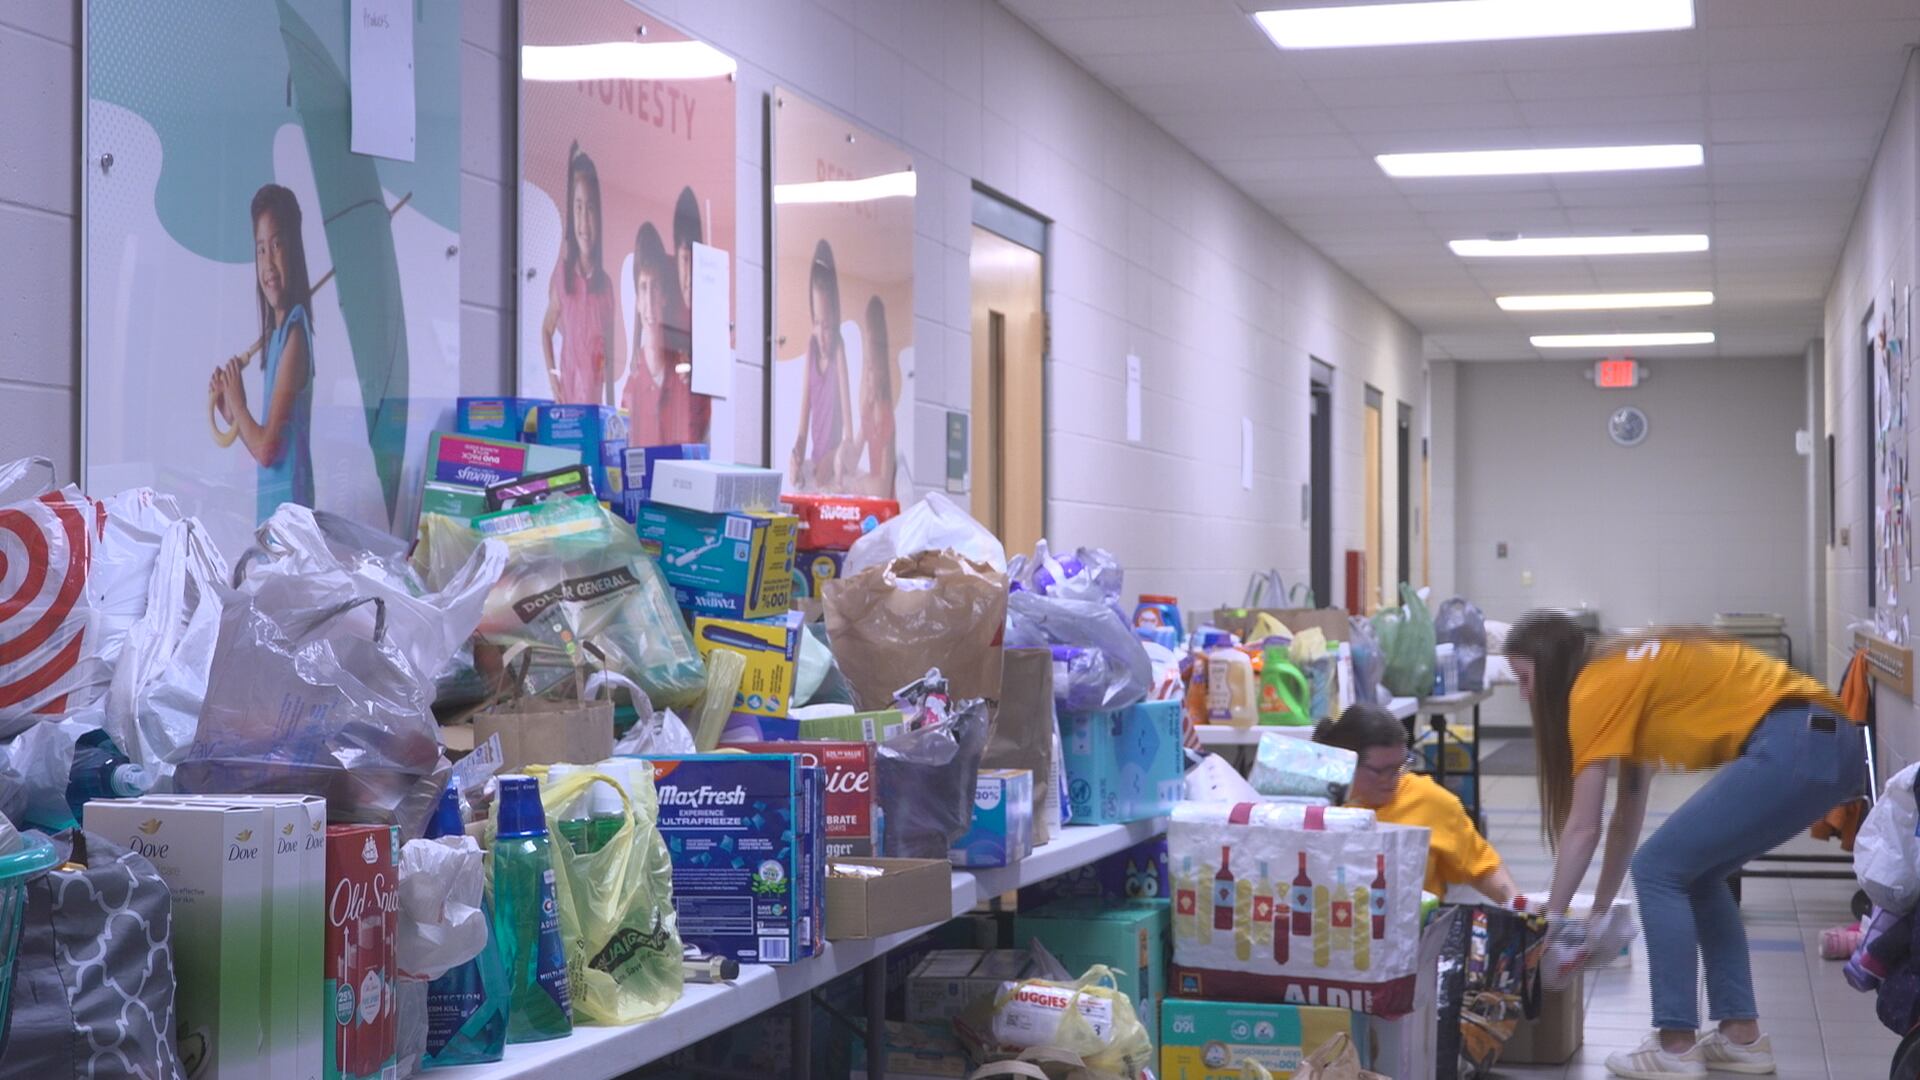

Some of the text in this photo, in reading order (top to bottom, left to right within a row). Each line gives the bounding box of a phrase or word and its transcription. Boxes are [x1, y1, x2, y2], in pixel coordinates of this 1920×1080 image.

[456, 466, 500, 486] always
[577, 574, 631, 597] GENERAL
[695, 596, 737, 610] TAMPAX
[658, 785, 746, 808] MaxFresh
[662, 817, 741, 826] ULTRAFREEZE
[826, 815, 857, 825] BRATE
[129, 835, 169, 859] Dove
[277, 837, 298, 855] Dove
[305, 834, 325, 851] Dove
[826, 843, 854, 857] gger
[229, 843, 258, 861] Dove
[329, 872, 401, 928] Old Spic
[428, 993, 480, 1001] OTECTION
[1173, 1020, 1195, 1033] 160
